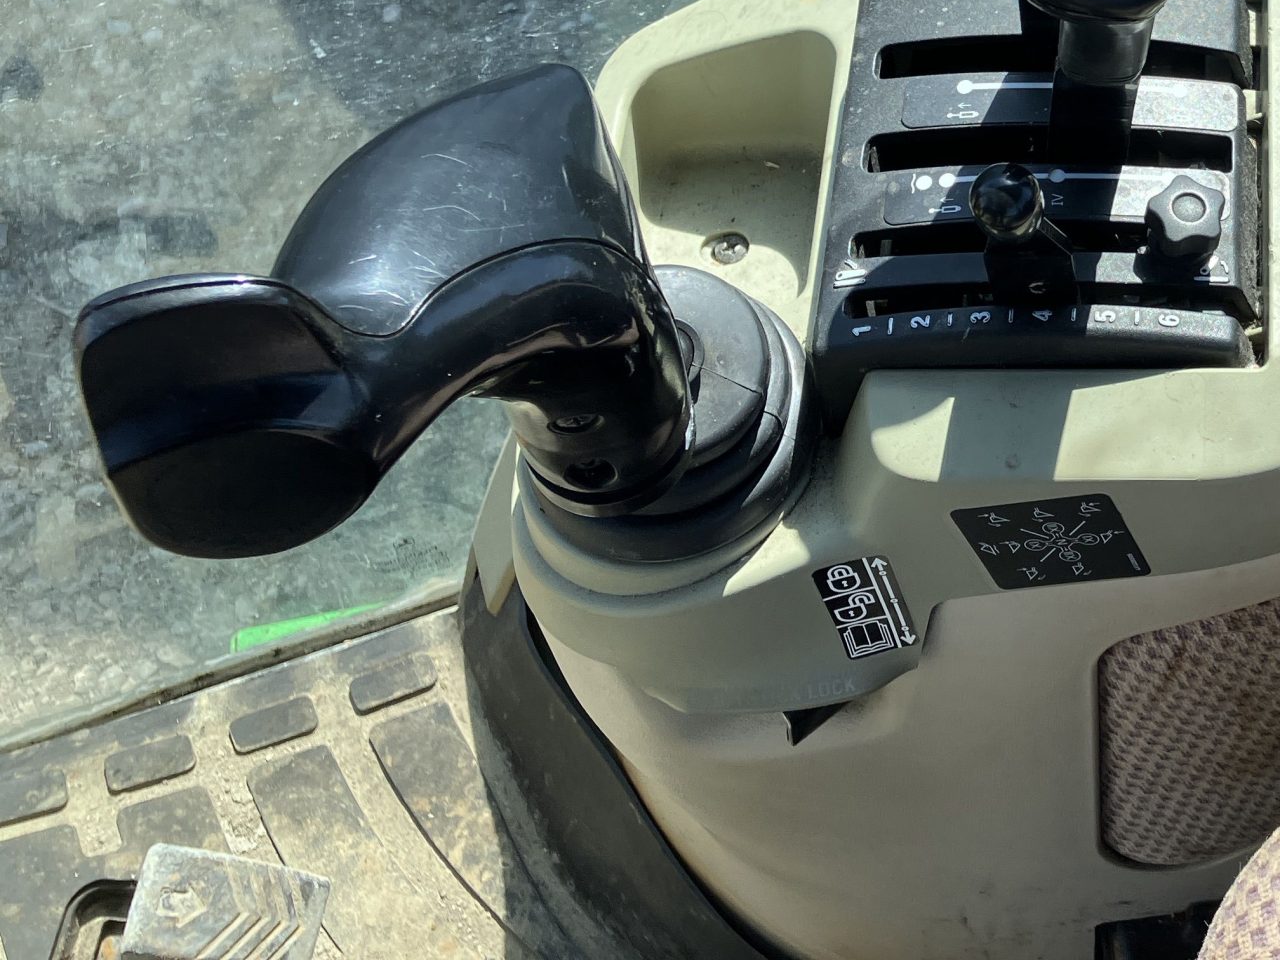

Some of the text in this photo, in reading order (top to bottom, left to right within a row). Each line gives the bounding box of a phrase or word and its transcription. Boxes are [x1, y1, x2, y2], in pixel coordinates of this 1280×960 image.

[851, 308, 1180, 337] 1 2 3 4 5 6
